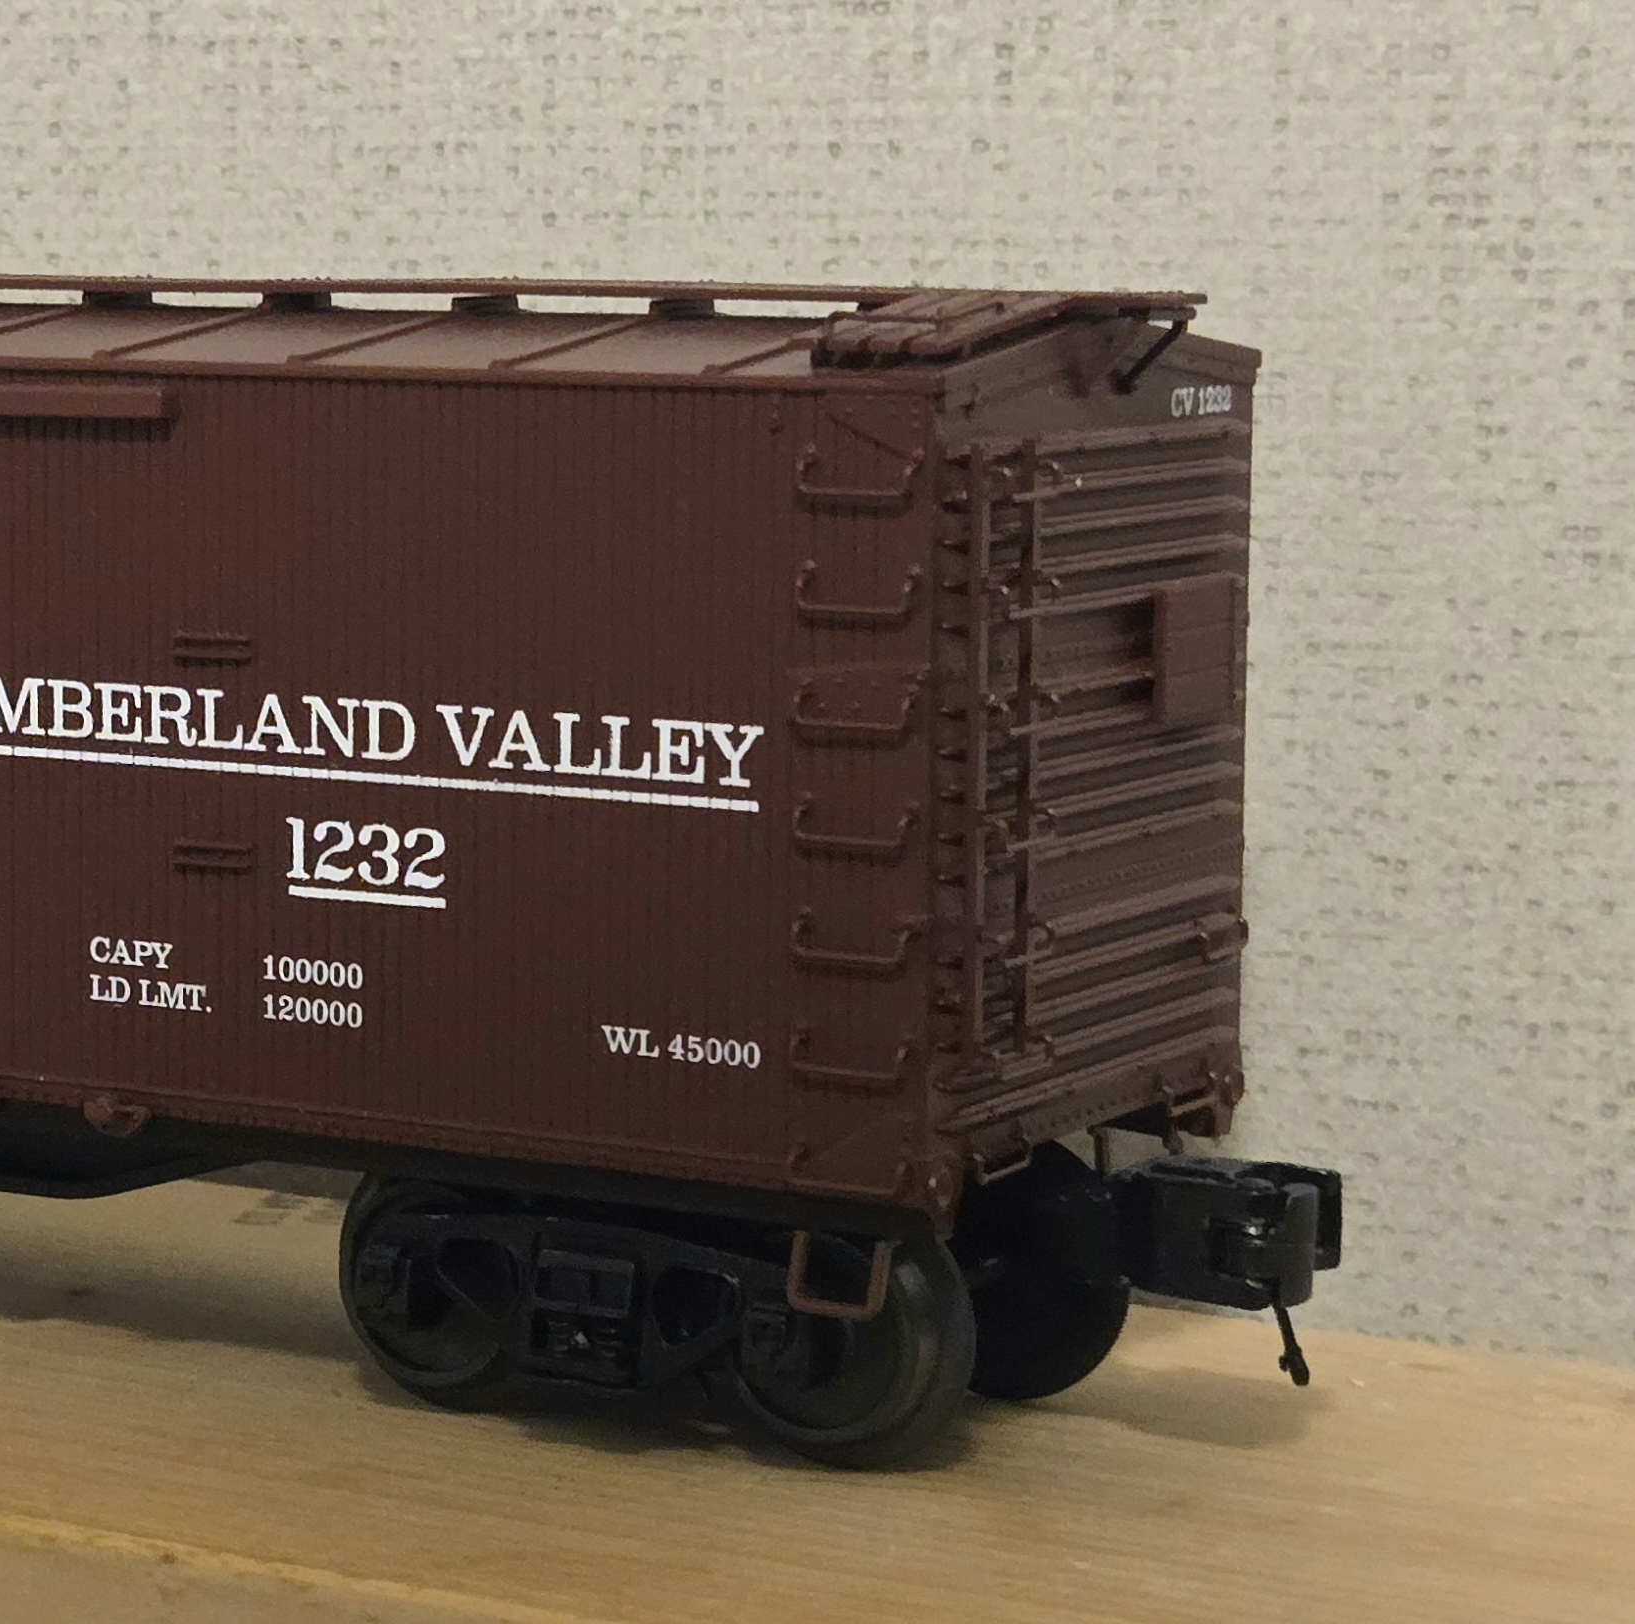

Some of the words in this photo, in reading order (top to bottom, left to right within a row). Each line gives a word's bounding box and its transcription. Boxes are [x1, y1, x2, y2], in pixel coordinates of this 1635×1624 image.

[1171, 387, 1195, 418] CV
[1198, 384, 1232, 415] 1232
[435, 704, 765, 788] VALLEY
[285, 816, 446, 890] 1232
[89, 935, 173, 969] CAPY
[263, 954, 363, 990] 100000
[89, 973, 131, 1003] LD
[138, 978, 212, 1013] LMT.
[263, 993, 363, 1028] 120000
[600, 1024, 660, 1058] WL
[667, 1033, 761, 1069] 45000
